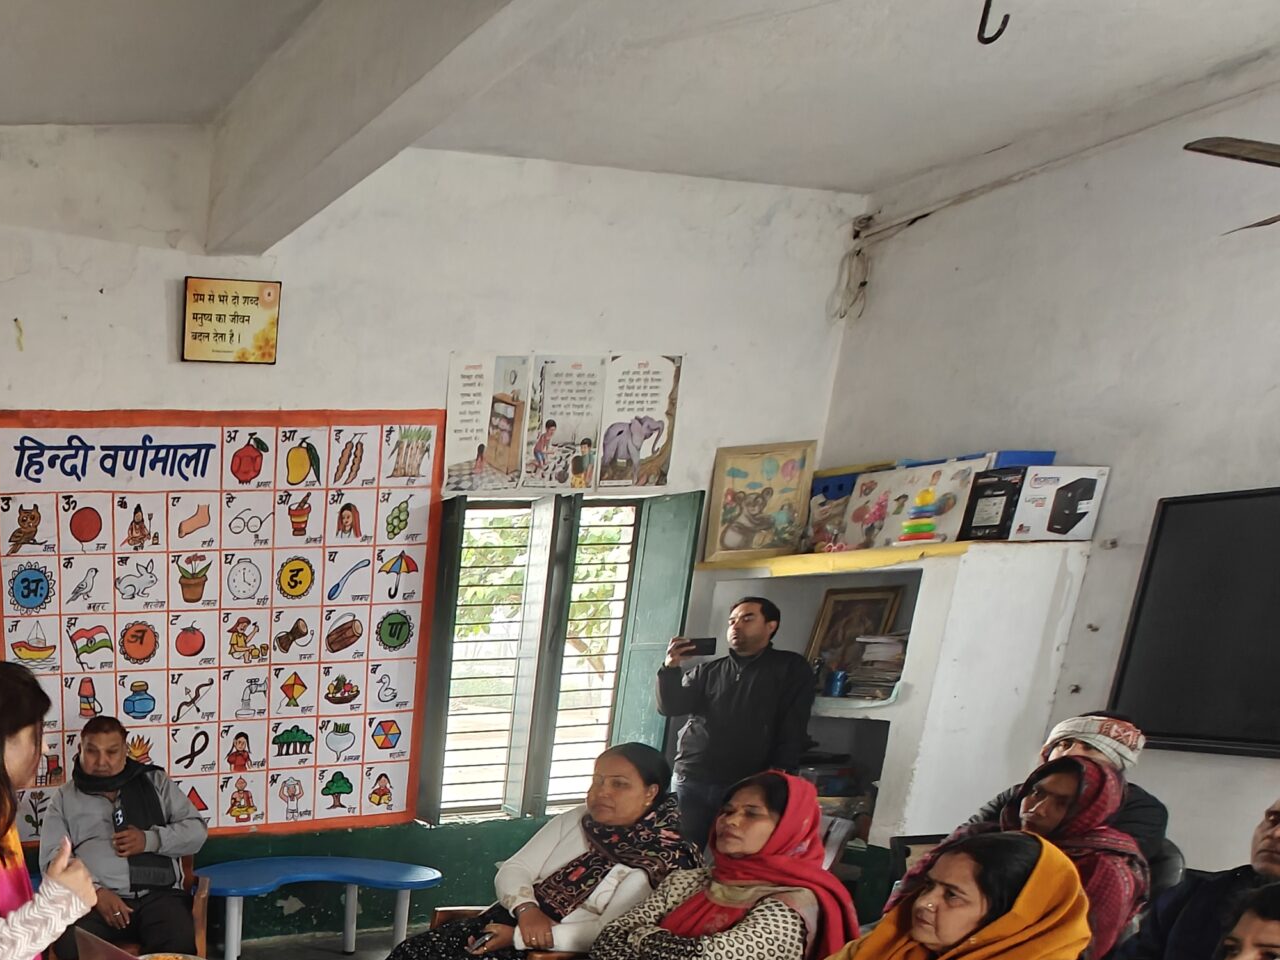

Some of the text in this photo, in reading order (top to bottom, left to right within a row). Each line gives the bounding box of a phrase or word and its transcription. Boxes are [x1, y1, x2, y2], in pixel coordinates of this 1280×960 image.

[208, 290, 215, 304] से
[218, 290, 228, 305] भरे
[231, 291, 239, 306] दो
[242, 295, 259, 308] शब्द
[215, 313, 226, 323] का
[229, 310, 250, 325] जीवन
[191, 331, 210, 344] बदल
[213, 328, 226, 343] देता
[226, 430, 238, 444] अ
[281, 430, 297, 442] आ
[334, 429, 344, 446] इ
[385, 426, 395, 446] ई
[14, 434, 217, 483] हिन्दी वर्णमाला
[171, 496, 181, 507] ए
[277, 490, 291, 505] ओ
[329, 488, 344, 504] औ
[0, 496, 11, 512] उ
[62, 495, 77, 513] ऊ
[171, 555, 180, 566] ग
[224, 554, 235, 565] घ
[328, 551, 338, 562] च
[62, 557, 74, 569] क
[170, 615, 181, 626] ट
[222, 612, 232, 623] ठ
[273, 611, 284, 623] ड
[324, 609, 335, 621] ढ
[8, 620, 20, 633] ज
[273, 667, 285, 678] प
[323, 666, 332, 677] फ
[370, 664, 382, 674] ब
[118, 675, 128, 688] द
[170, 673, 182, 684] ध
[220, 725, 233, 737] ल
[272, 722, 281, 733] व
[66, 734, 76, 746] म
[172, 728, 180, 742] र
